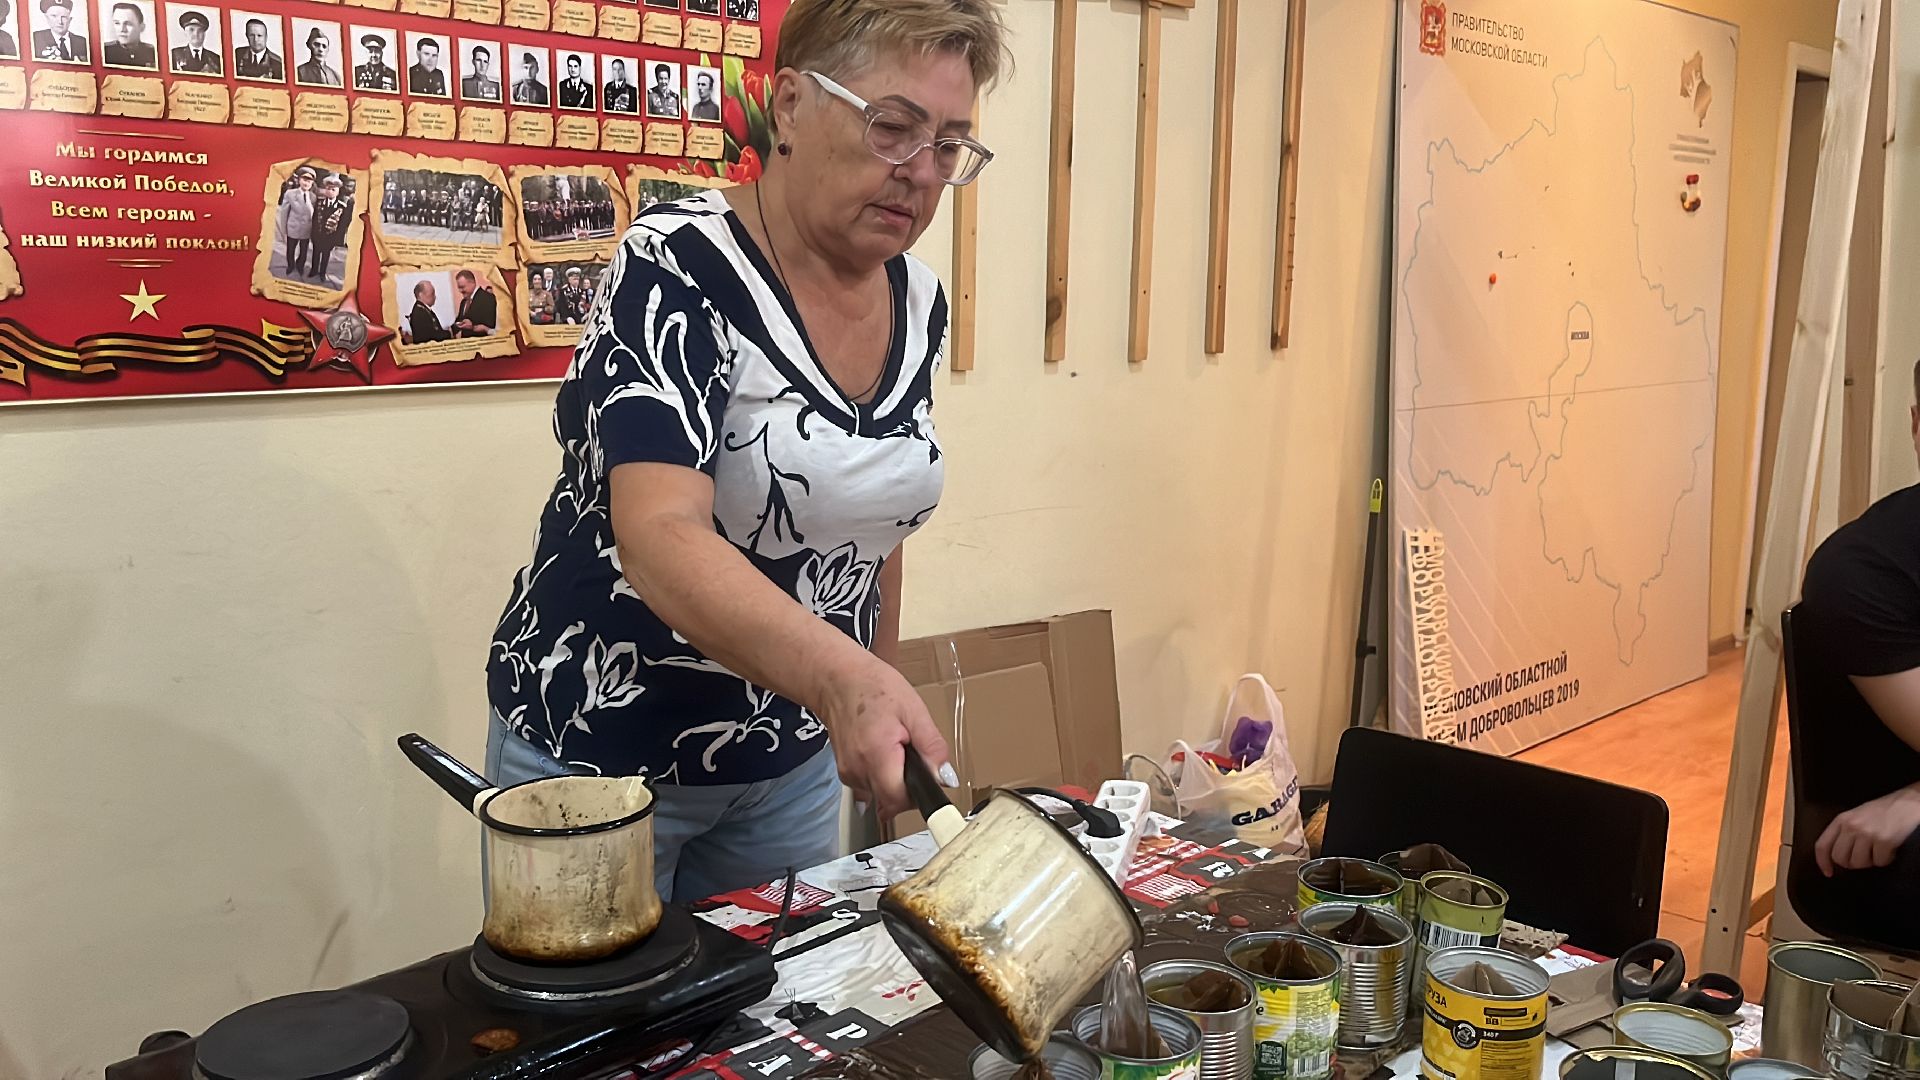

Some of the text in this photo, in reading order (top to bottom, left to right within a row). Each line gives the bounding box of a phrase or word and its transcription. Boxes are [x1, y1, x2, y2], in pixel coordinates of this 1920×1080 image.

[1452, 12, 1524, 41] ПРАВИТЕЛЬСТВО
[1451, 36, 1548, 68] МОСКОВСКОЙ ОБЛАСТИ
[56, 141, 208, 165] Мы гордимся
[29, 169, 235, 197] Великой Победой,
[51, 200, 109, 218] Всем
[117, 207, 196, 224] героям
[21, 233, 249, 251] наш низкий поклон!
[1505, 650, 1568, 693] ОБЛАСТНОЙ
[1469, 689, 1555, 743] ДОБРОВОЛЬЦЕВ
[1557, 679, 1580, 704] 2019
[832, 908, 861, 921] S
[826, 1022, 868, 1041] P
[748, 1054, 792, 1076] A
